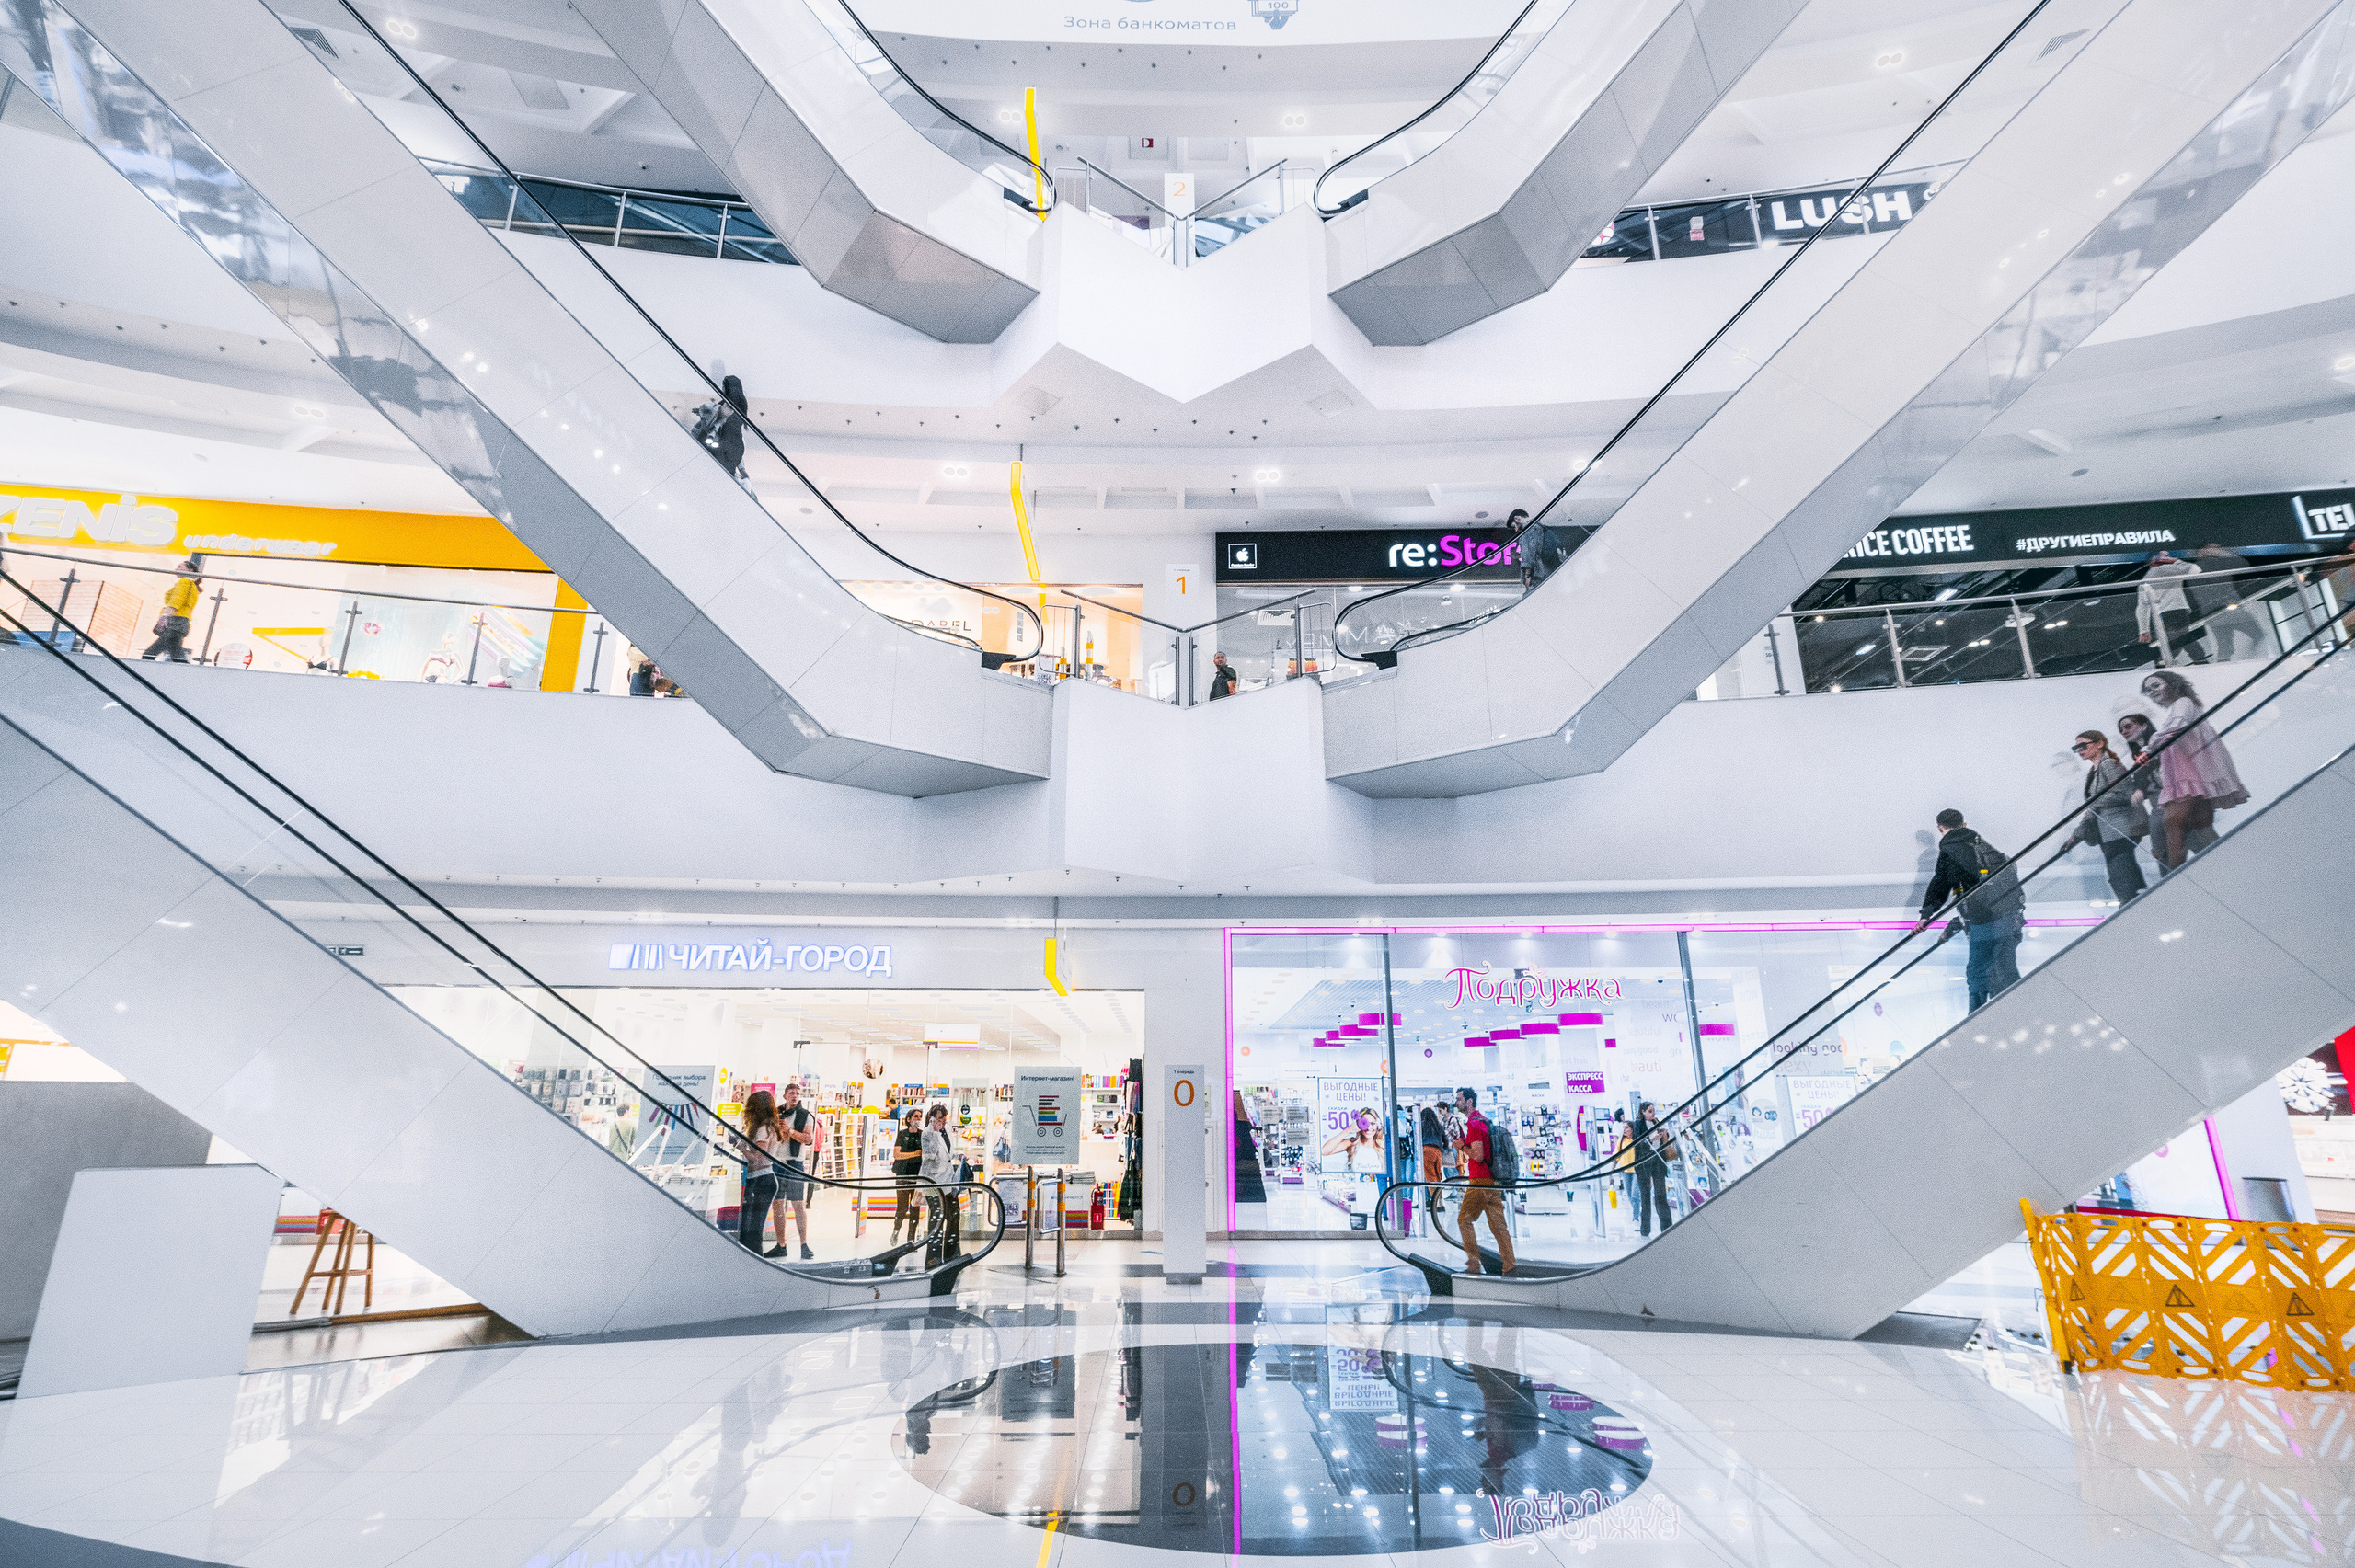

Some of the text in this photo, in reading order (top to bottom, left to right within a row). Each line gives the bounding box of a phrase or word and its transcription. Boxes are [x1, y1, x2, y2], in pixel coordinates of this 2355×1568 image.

[1268, 1, 1289, 9] 100
[1063, 16, 1236, 30] Зона банкоматов
[1173, 181, 1185, 196] 2
[1771, 191, 1912, 231] LUSH
[183, 533, 338, 555] underwear
[1842, 525, 1974, 558] ICE COFFEE
[2016, 529, 2177, 553] #ДРУГИЕПРАВИЛА
[1389, 534, 1522, 567] re:Stor
[1176, 576, 1186, 594] 1
[669, 937, 893, 978] ЧИТАЙ-ГОРОД
[1442, 960, 1625, 1010] Подружка
[1568, 1072, 1603, 1082] ЭКСПРЕСС
[1793, 1079, 1852, 1090] ВЫГОДНЫЕ
[1174, 1079, 1195, 1107] 0
[1323, 1082, 1378, 1092] ВЫГОДНЫЕ
[1568, 1084, 1593, 1093] КАССА
[1336, 1093, 1366, 1102] ЦЕНЫ!
